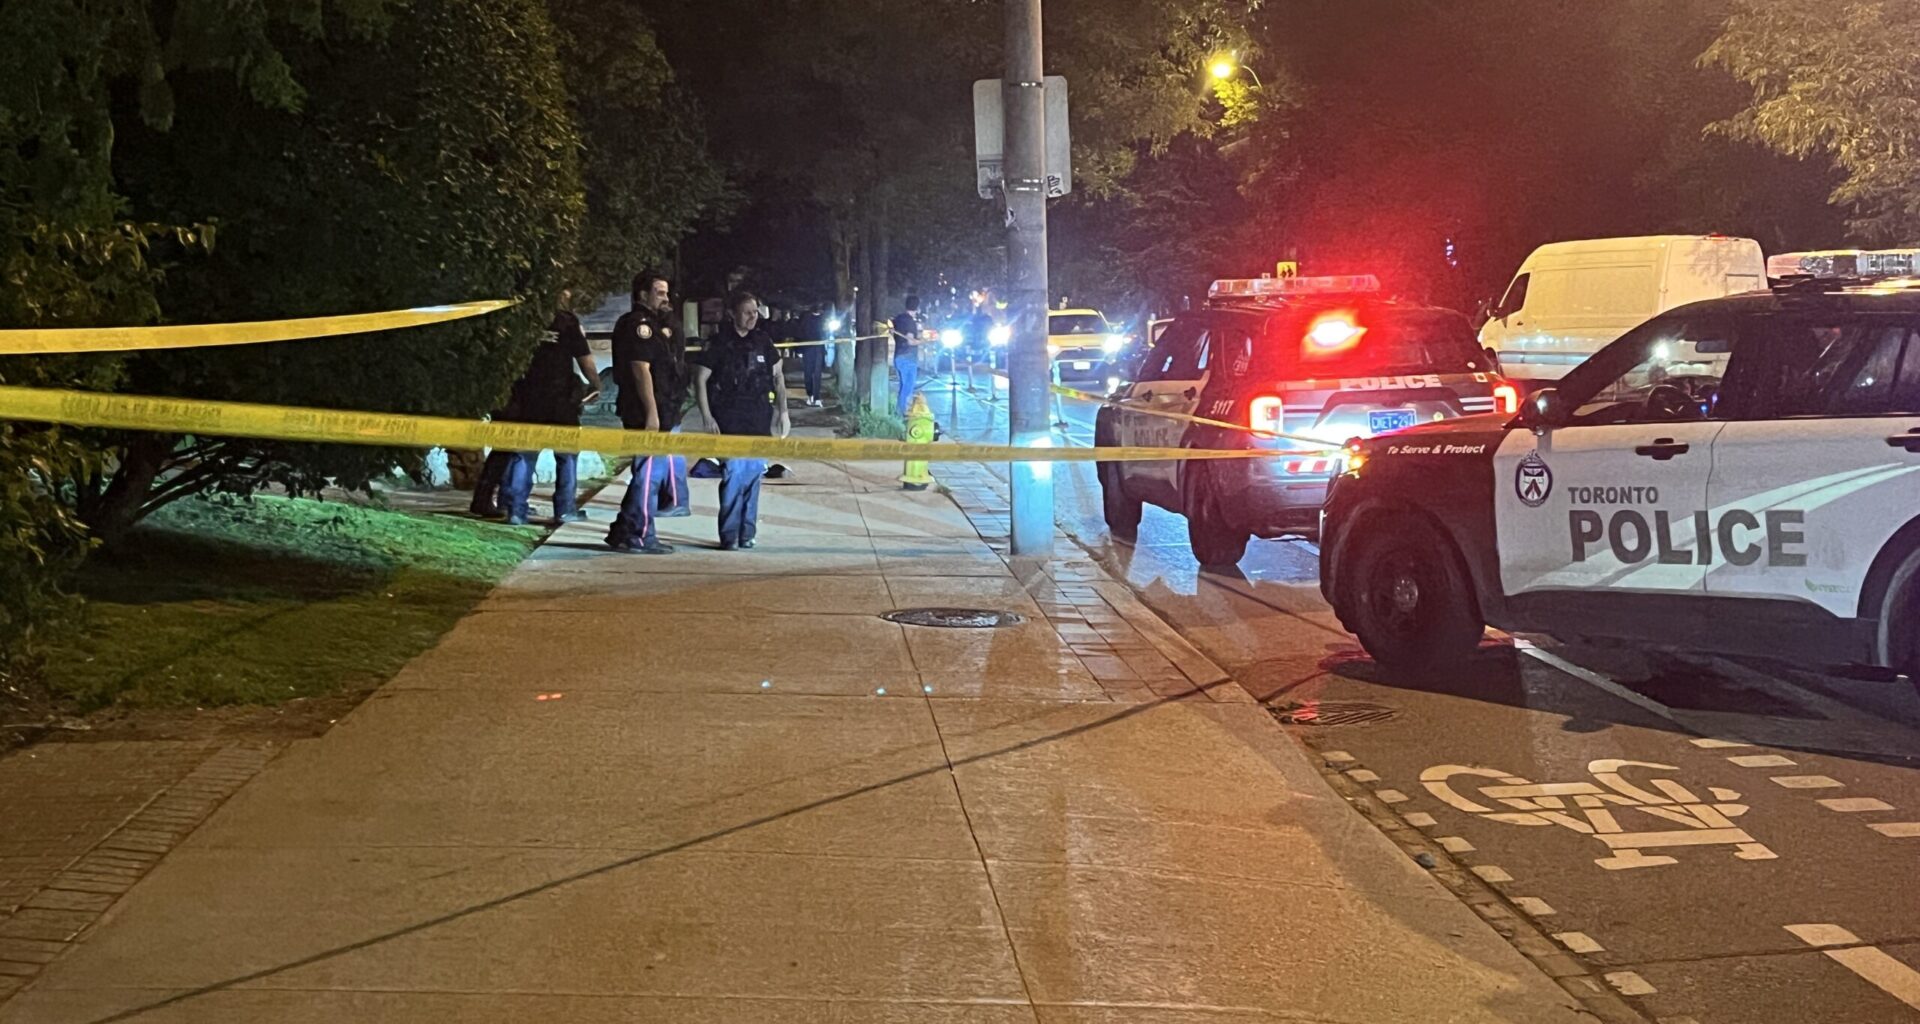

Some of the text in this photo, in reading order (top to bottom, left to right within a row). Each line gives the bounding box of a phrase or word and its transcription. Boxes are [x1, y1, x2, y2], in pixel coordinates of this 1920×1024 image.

[1340, 374, 1442, 392] POLICE
[1211, 400, 1235, 415] 5117
[1387, 444, 1486, 454] To Serve & Protect
[1568, 486, 1659, 504] TORONTO
[1568, 509, 1808, 567] POLICE
